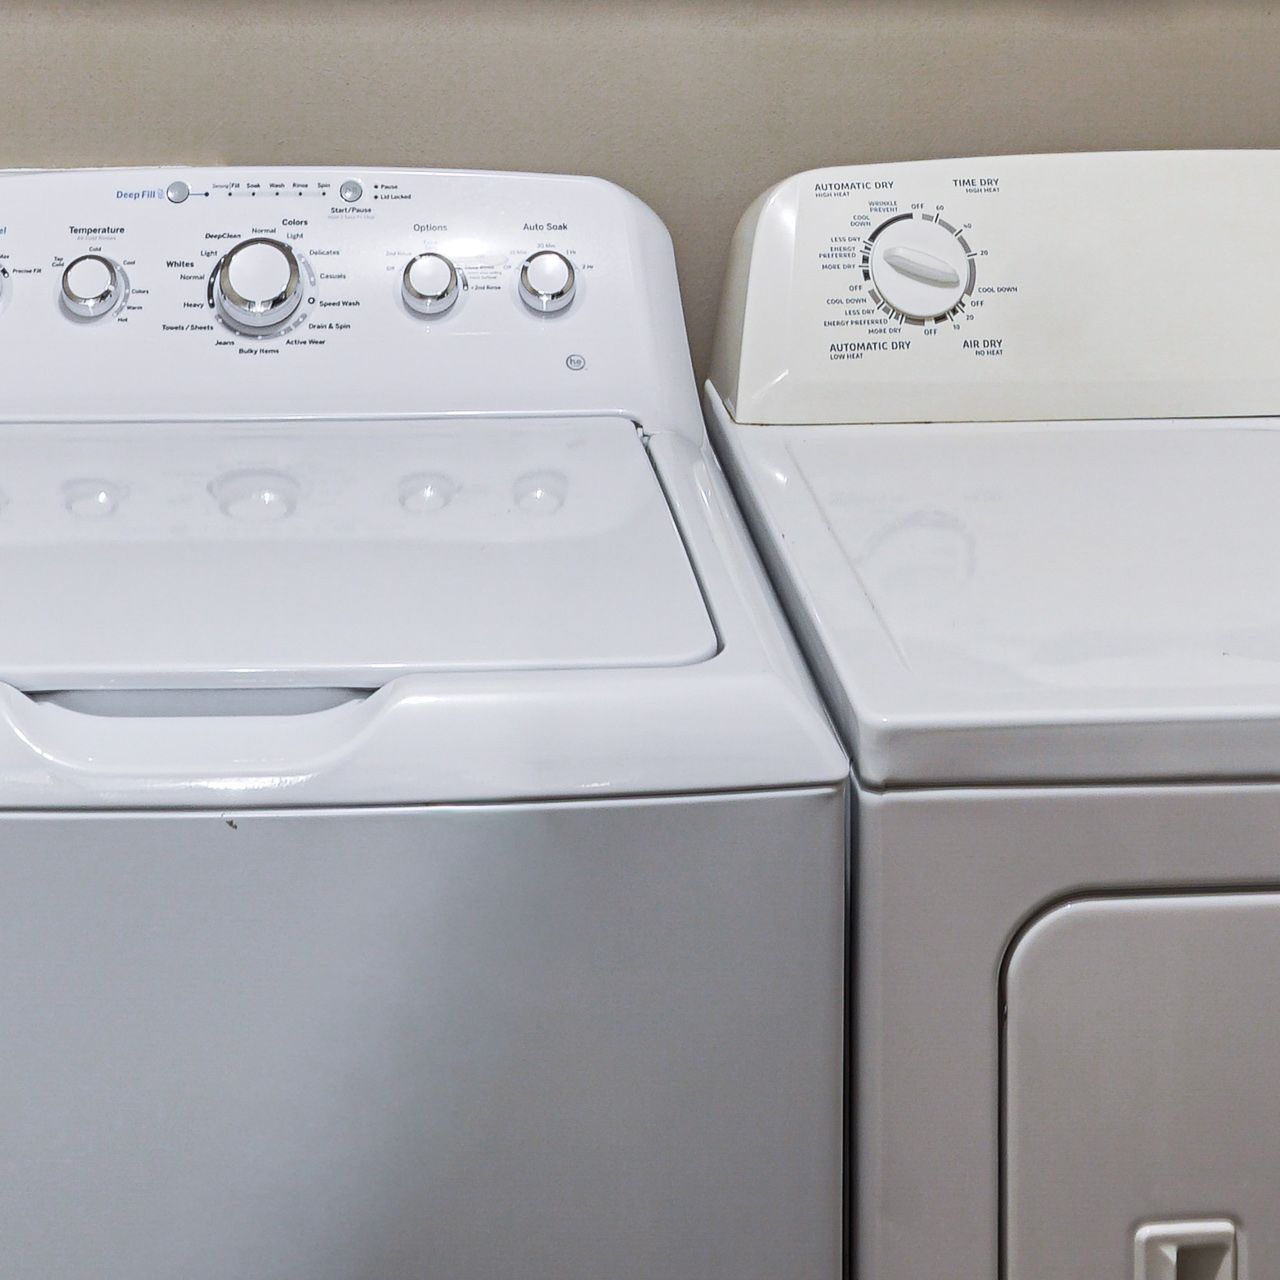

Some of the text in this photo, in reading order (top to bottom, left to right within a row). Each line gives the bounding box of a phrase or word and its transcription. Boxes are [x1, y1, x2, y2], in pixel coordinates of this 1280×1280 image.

[814, 181, 894, 191] AUTOMATIC DRY
[952, 178, 999, 187] TIME DRY
[116, 190, 155, 200] Deep Fill
[69, 226, 125, 235] Temperature
[413, 224, 448, 233] Options
[523, 223, 568, 231] Auto Soak
[829, 341, 911, 352] AUTOMATIC DRY
[963, 339, 1003, 349] AIR DRY
